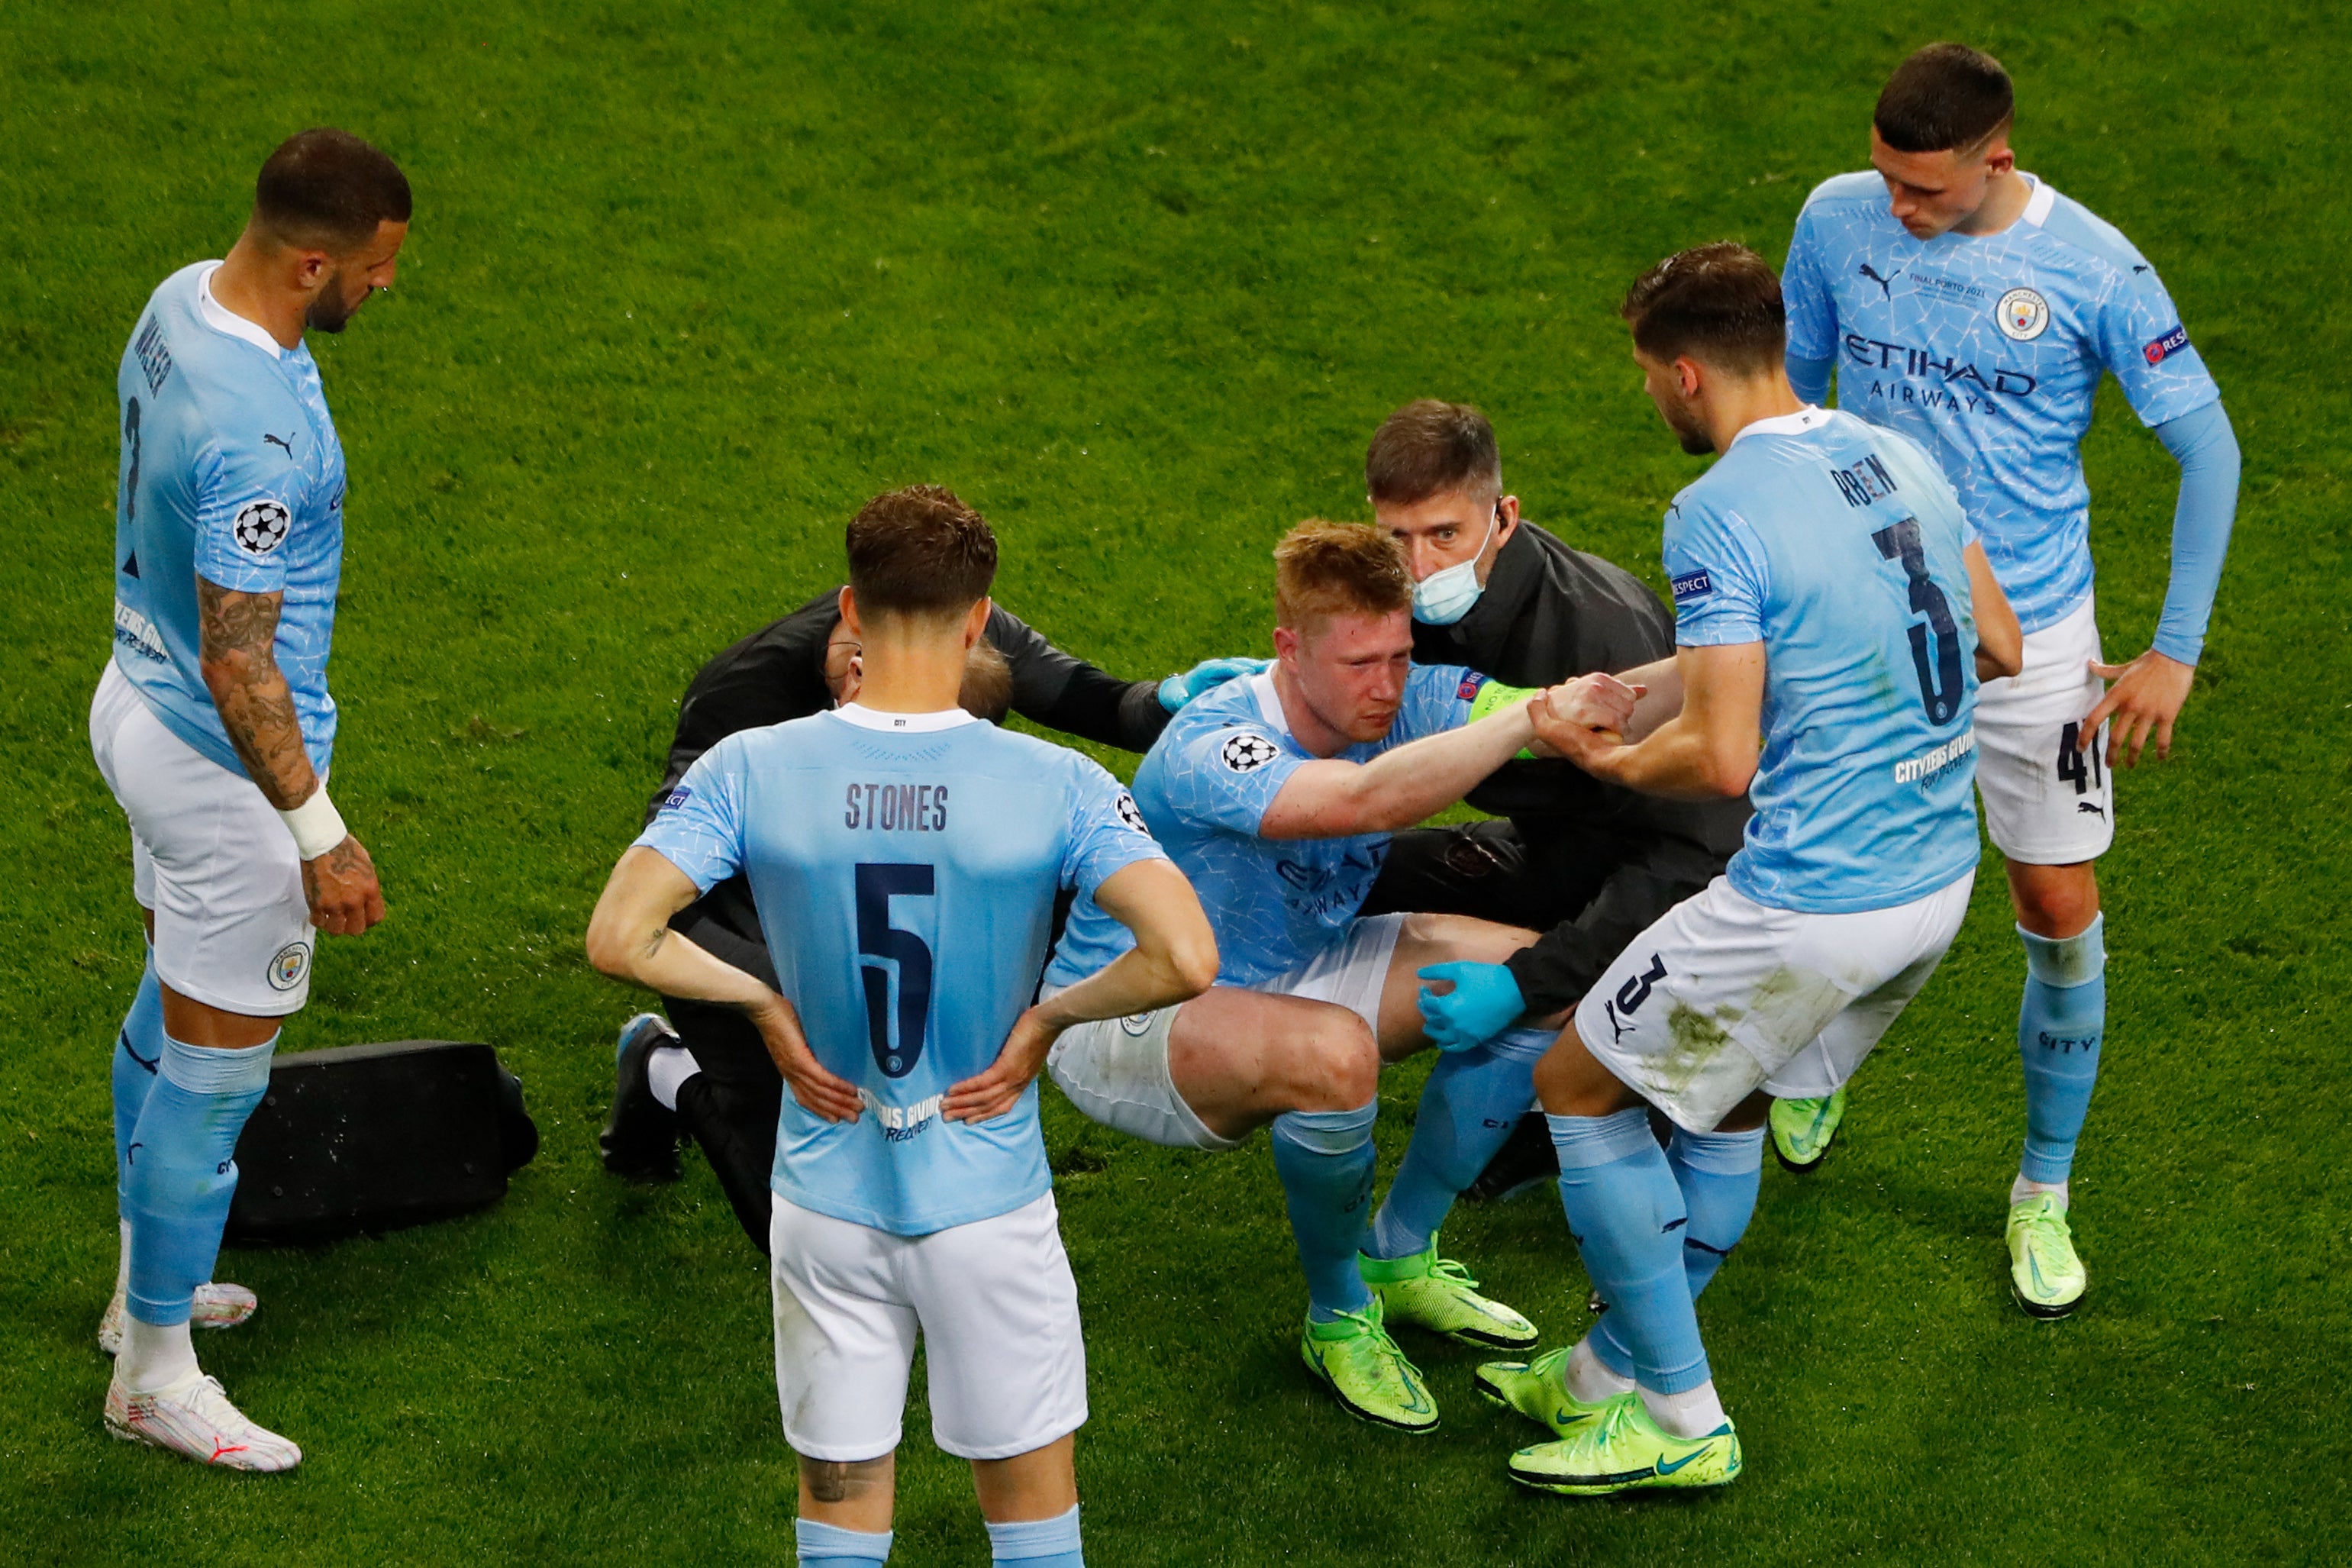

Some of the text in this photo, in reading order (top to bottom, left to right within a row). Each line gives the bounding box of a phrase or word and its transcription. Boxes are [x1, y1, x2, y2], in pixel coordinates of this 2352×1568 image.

[1910, 273, 1934, 286] FINAL
[1935, 279, 1964, 292] PORTO
[1966, 286, 1986, 298] 2021
[134, 311, 172, 400] WALKER
[1846, 334, 2037, 397] ETIHAD
[1870, 379, 1997, 415] AIRWAYS
[1870, 516, 1964, 726] 3
[845, 783, 948, 831] STONES
[855, 863, 934, 1078] 5
[1616, 953, 1668, 1015] 3
[2039, 1031, 2096, 1054] CITY
